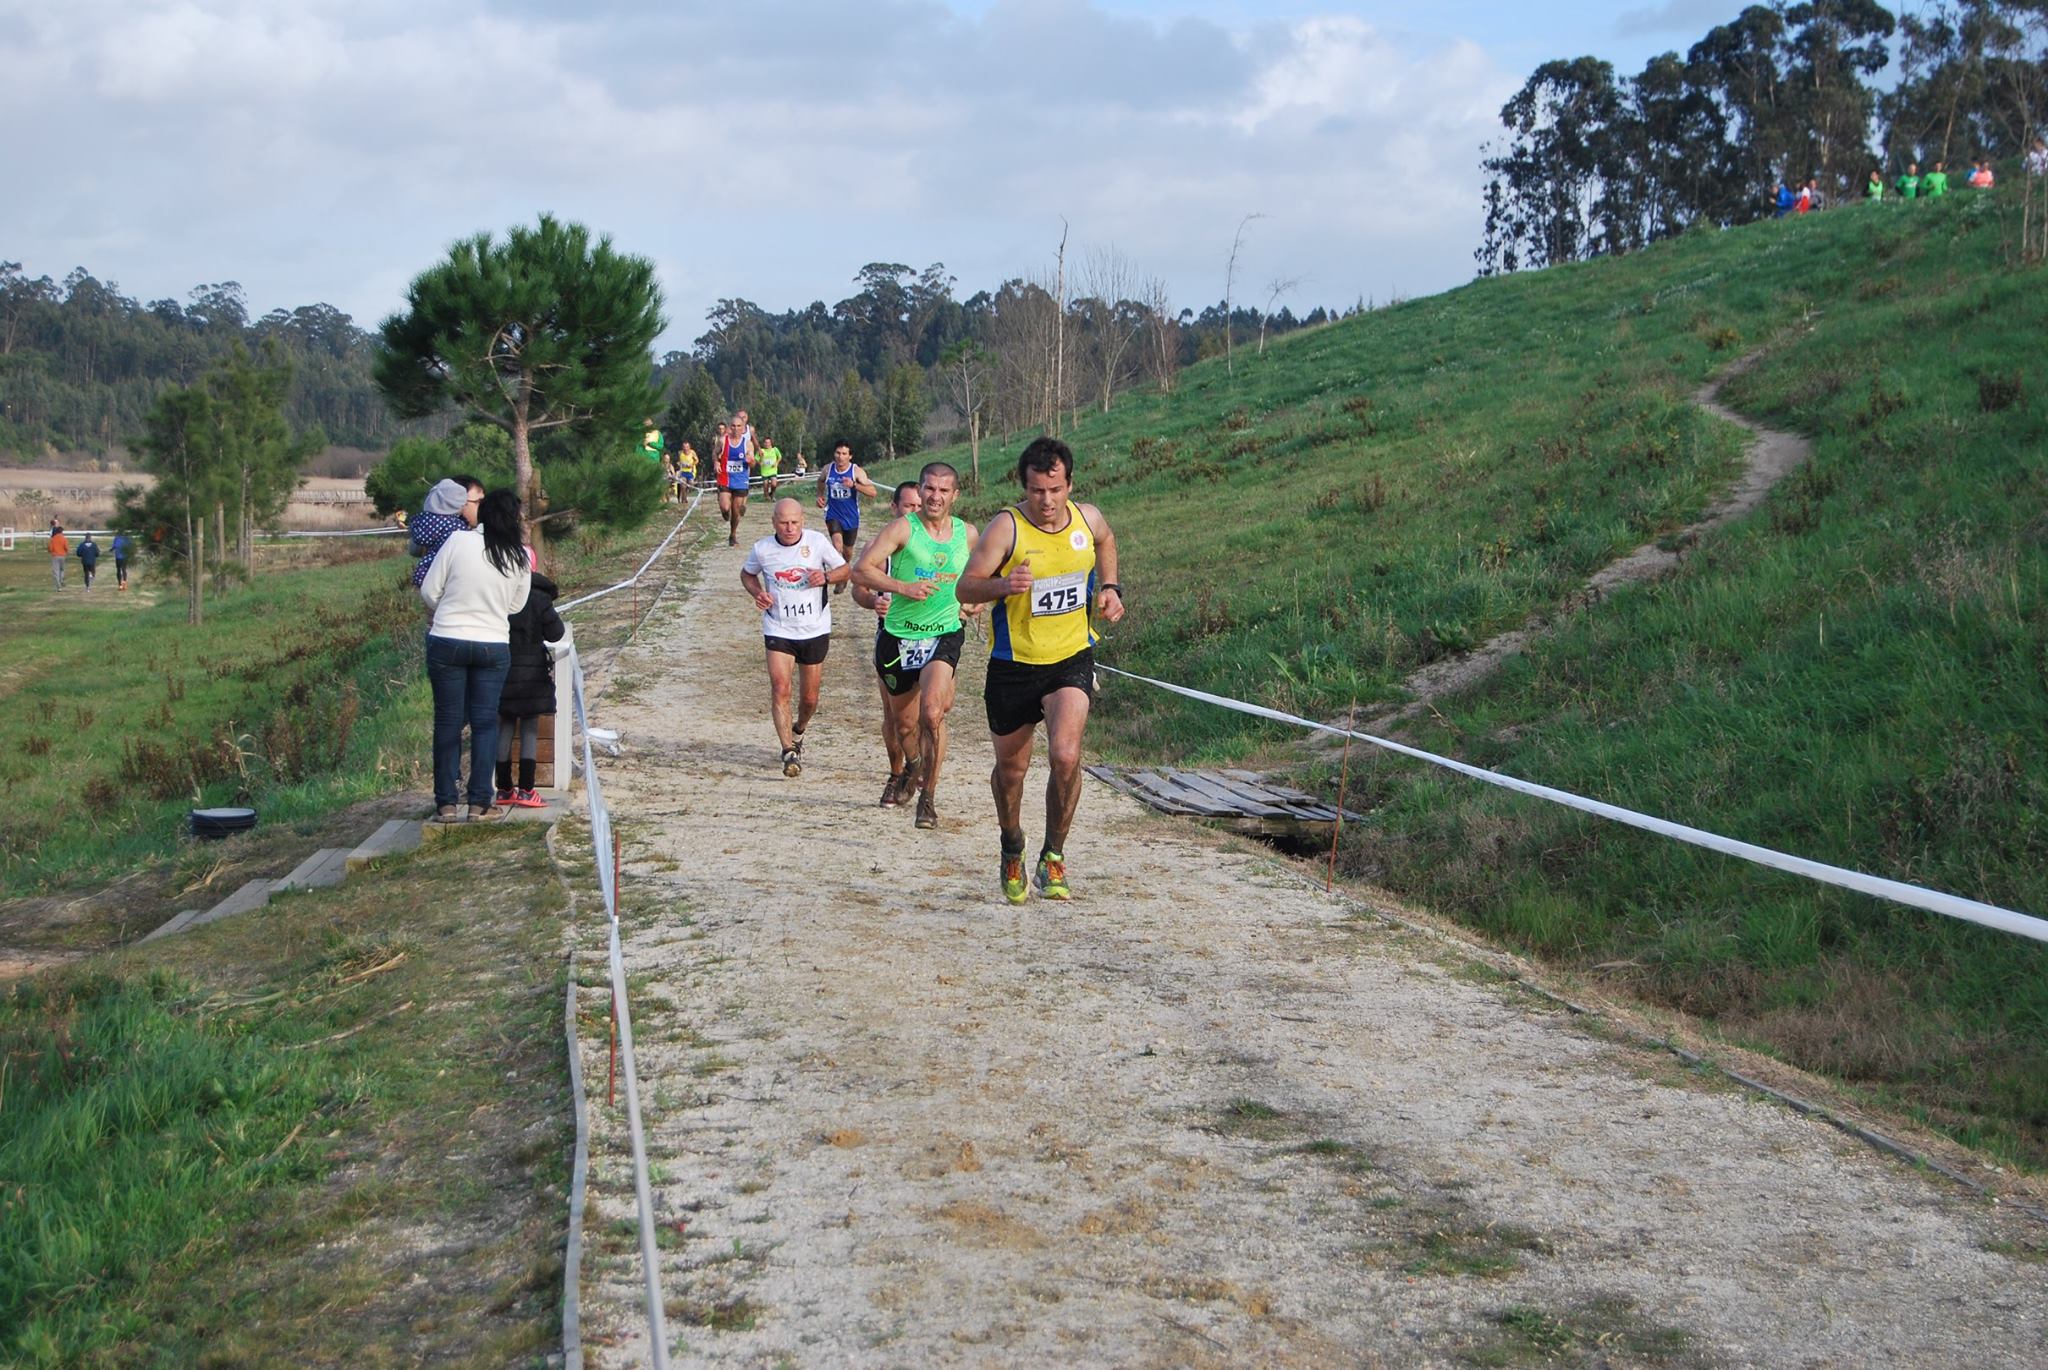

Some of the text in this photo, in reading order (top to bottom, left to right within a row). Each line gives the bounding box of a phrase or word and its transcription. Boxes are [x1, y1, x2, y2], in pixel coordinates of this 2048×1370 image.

[1038, 587, 1078, 610] 475
[784, 603, 812, 617] 1141
[904, 620, 944, 632] macron
